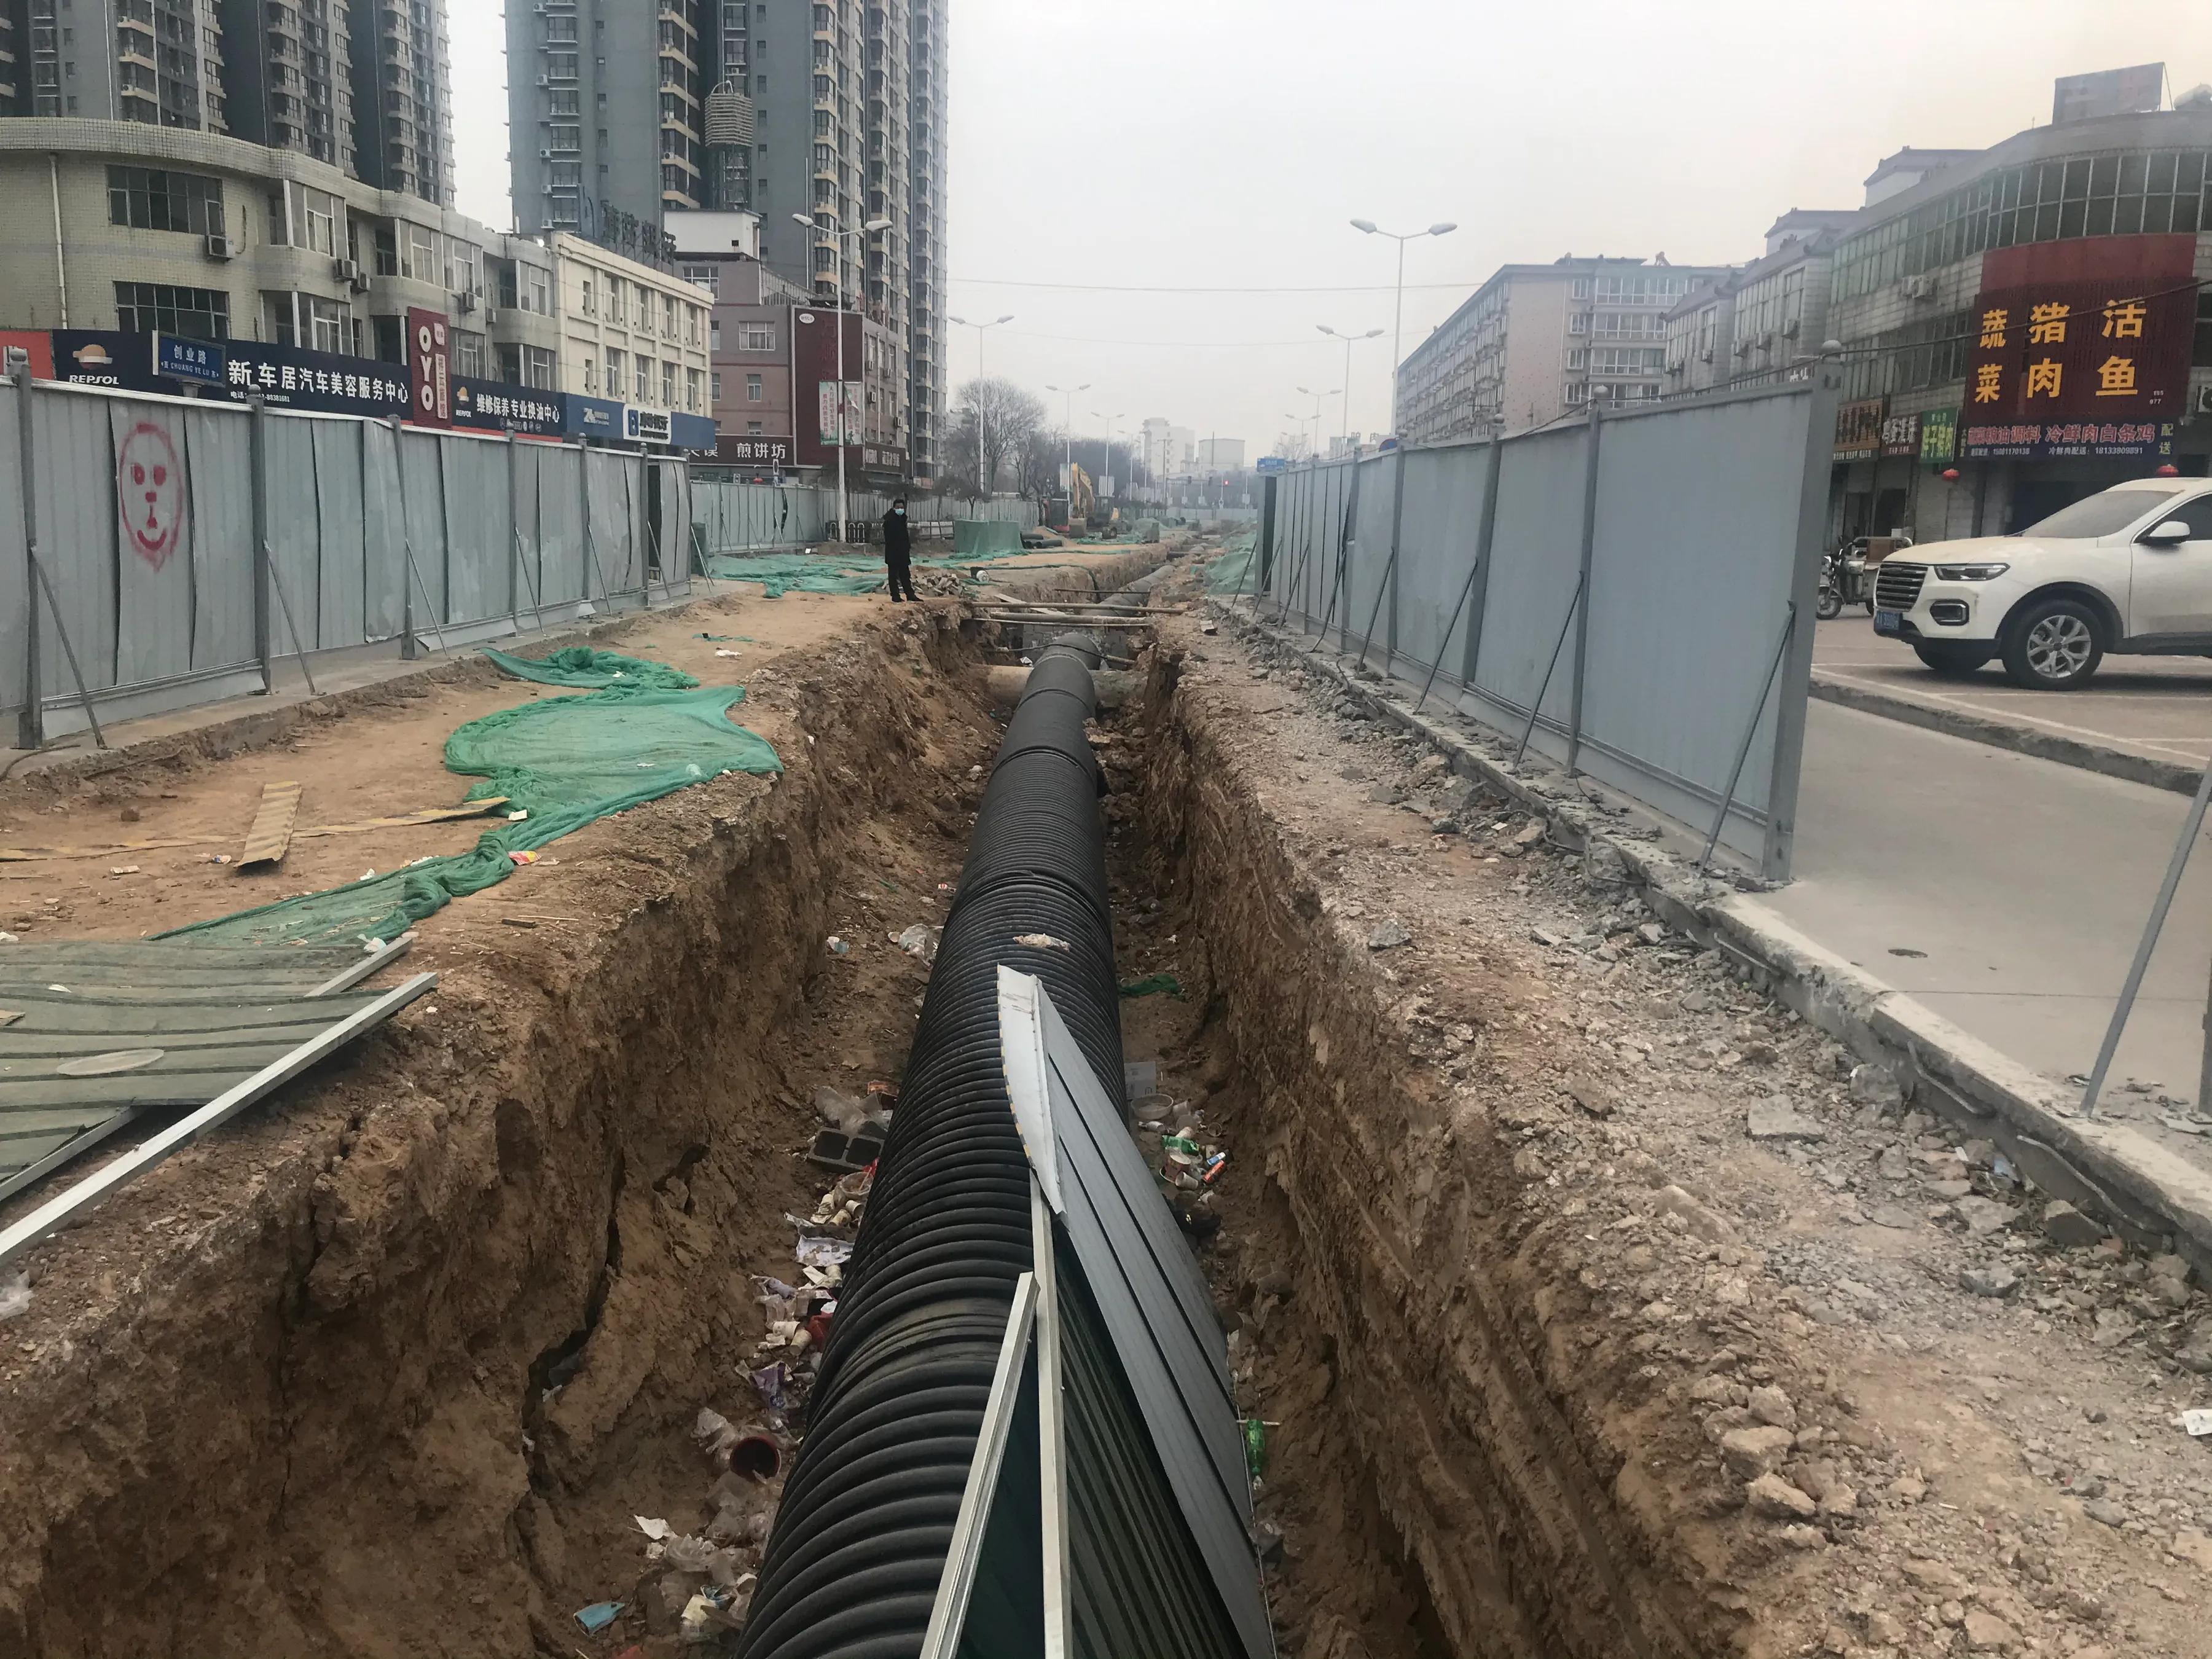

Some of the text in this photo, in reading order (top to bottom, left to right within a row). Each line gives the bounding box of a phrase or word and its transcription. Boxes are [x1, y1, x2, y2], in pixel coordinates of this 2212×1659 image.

[174, 345, 206, 365] 创业路
[1974, 309, 2009, 403] 蔬菜
[2027, 302, 2071, 399] 猪肉
[170, 363, 193, 372] CHUANG
[418, 326, 434, 411] OYO
[69, 374, 119, 385] REPSOL
[227, 359, 409, 404] 新车居汽车美容服务中心
[2044, 423, 2155, 444] 冷鲜肉白条鸡
[736, 442, 786, 459] 煎饼坊
